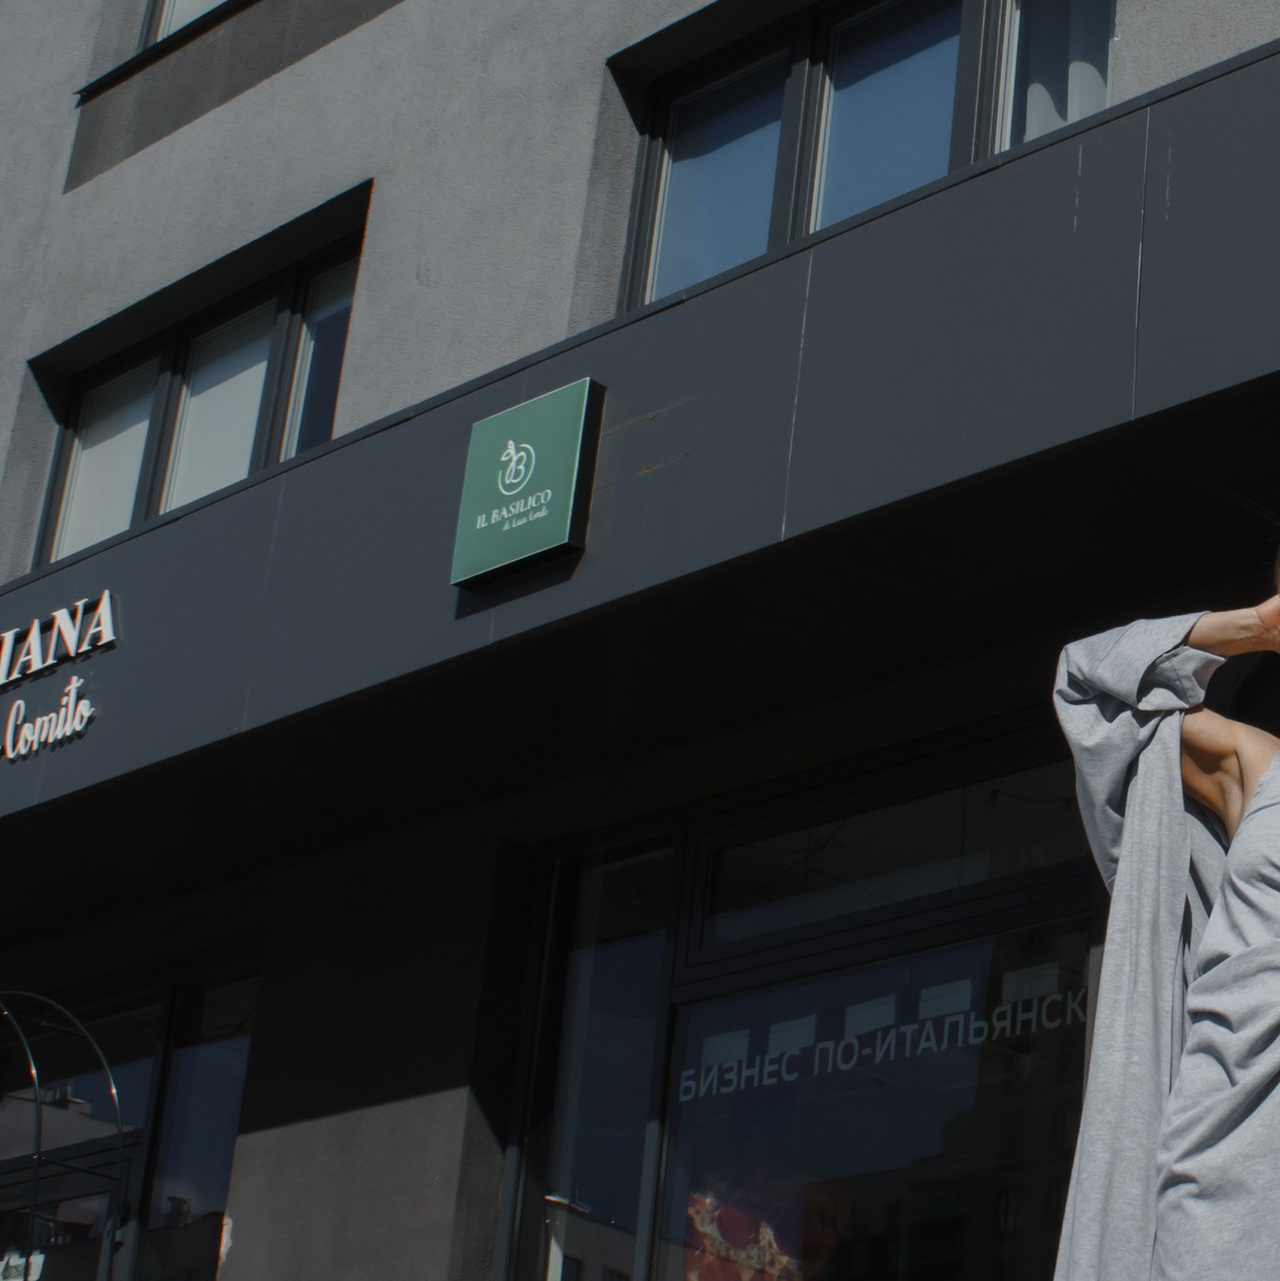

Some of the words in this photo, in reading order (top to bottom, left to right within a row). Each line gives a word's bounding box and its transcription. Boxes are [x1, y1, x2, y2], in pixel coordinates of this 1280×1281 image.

[475, 513, 489, 530] IL
[490, 488, 552, 525] BASILICO
[4, 675, 96, 759] Comito
[678, 1048, 803, 1103] БИЗНЕС
